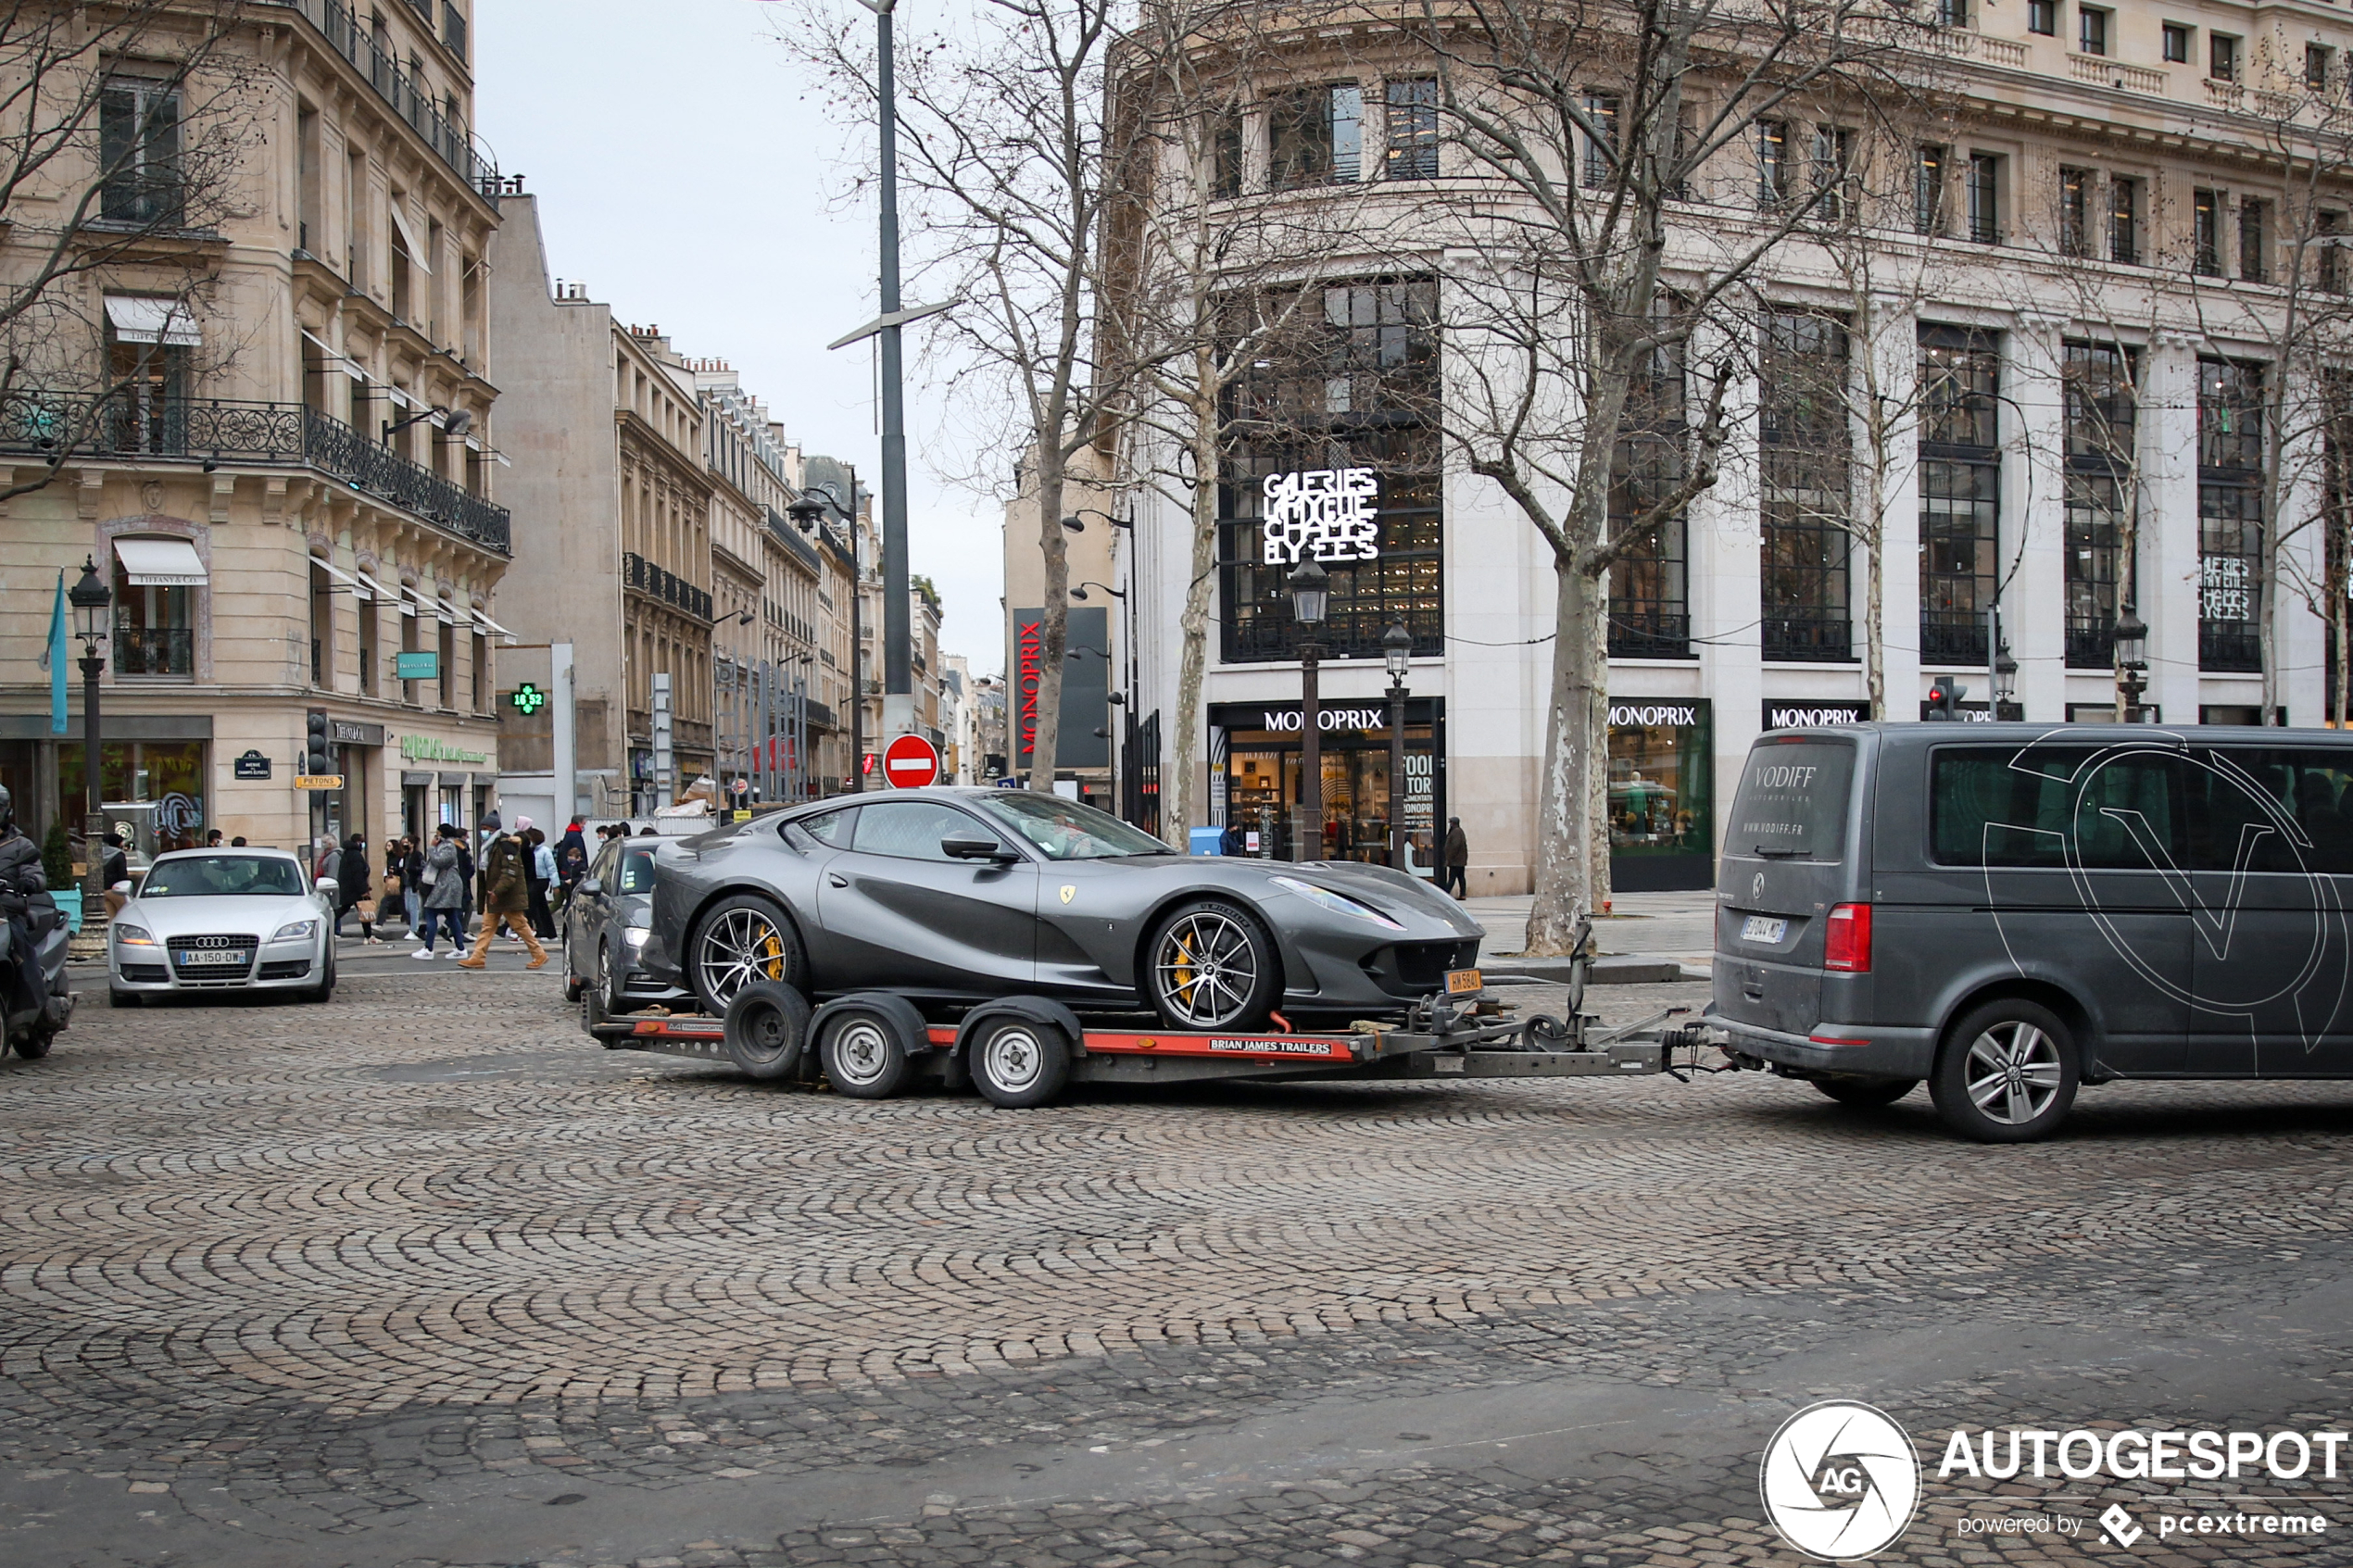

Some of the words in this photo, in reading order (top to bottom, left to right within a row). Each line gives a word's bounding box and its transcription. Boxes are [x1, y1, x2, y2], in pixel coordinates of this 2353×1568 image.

[1264, 467, 1378, 497] GALERIES
[1264, 514, 1378, 542] CHAMPS
[1021, 621, 1040, 754] MONOPRIX
[1265, 709, 1384, 731] MOOPRIX
[1771, 708, 1858, 728] MONOPRIX
[1755, 766, 1816, 788] VODIFF
[1743, 822, 1803, 834] WWW.VODIFF.FR
[187, 952, 239, 963] AA-150-DW
[1211, 1039, 1242, 1049] BRIAN
[1243, 1040, 1277, 1051] JAMES
[1279, 1042, 1330, 1054] TRAILERS
